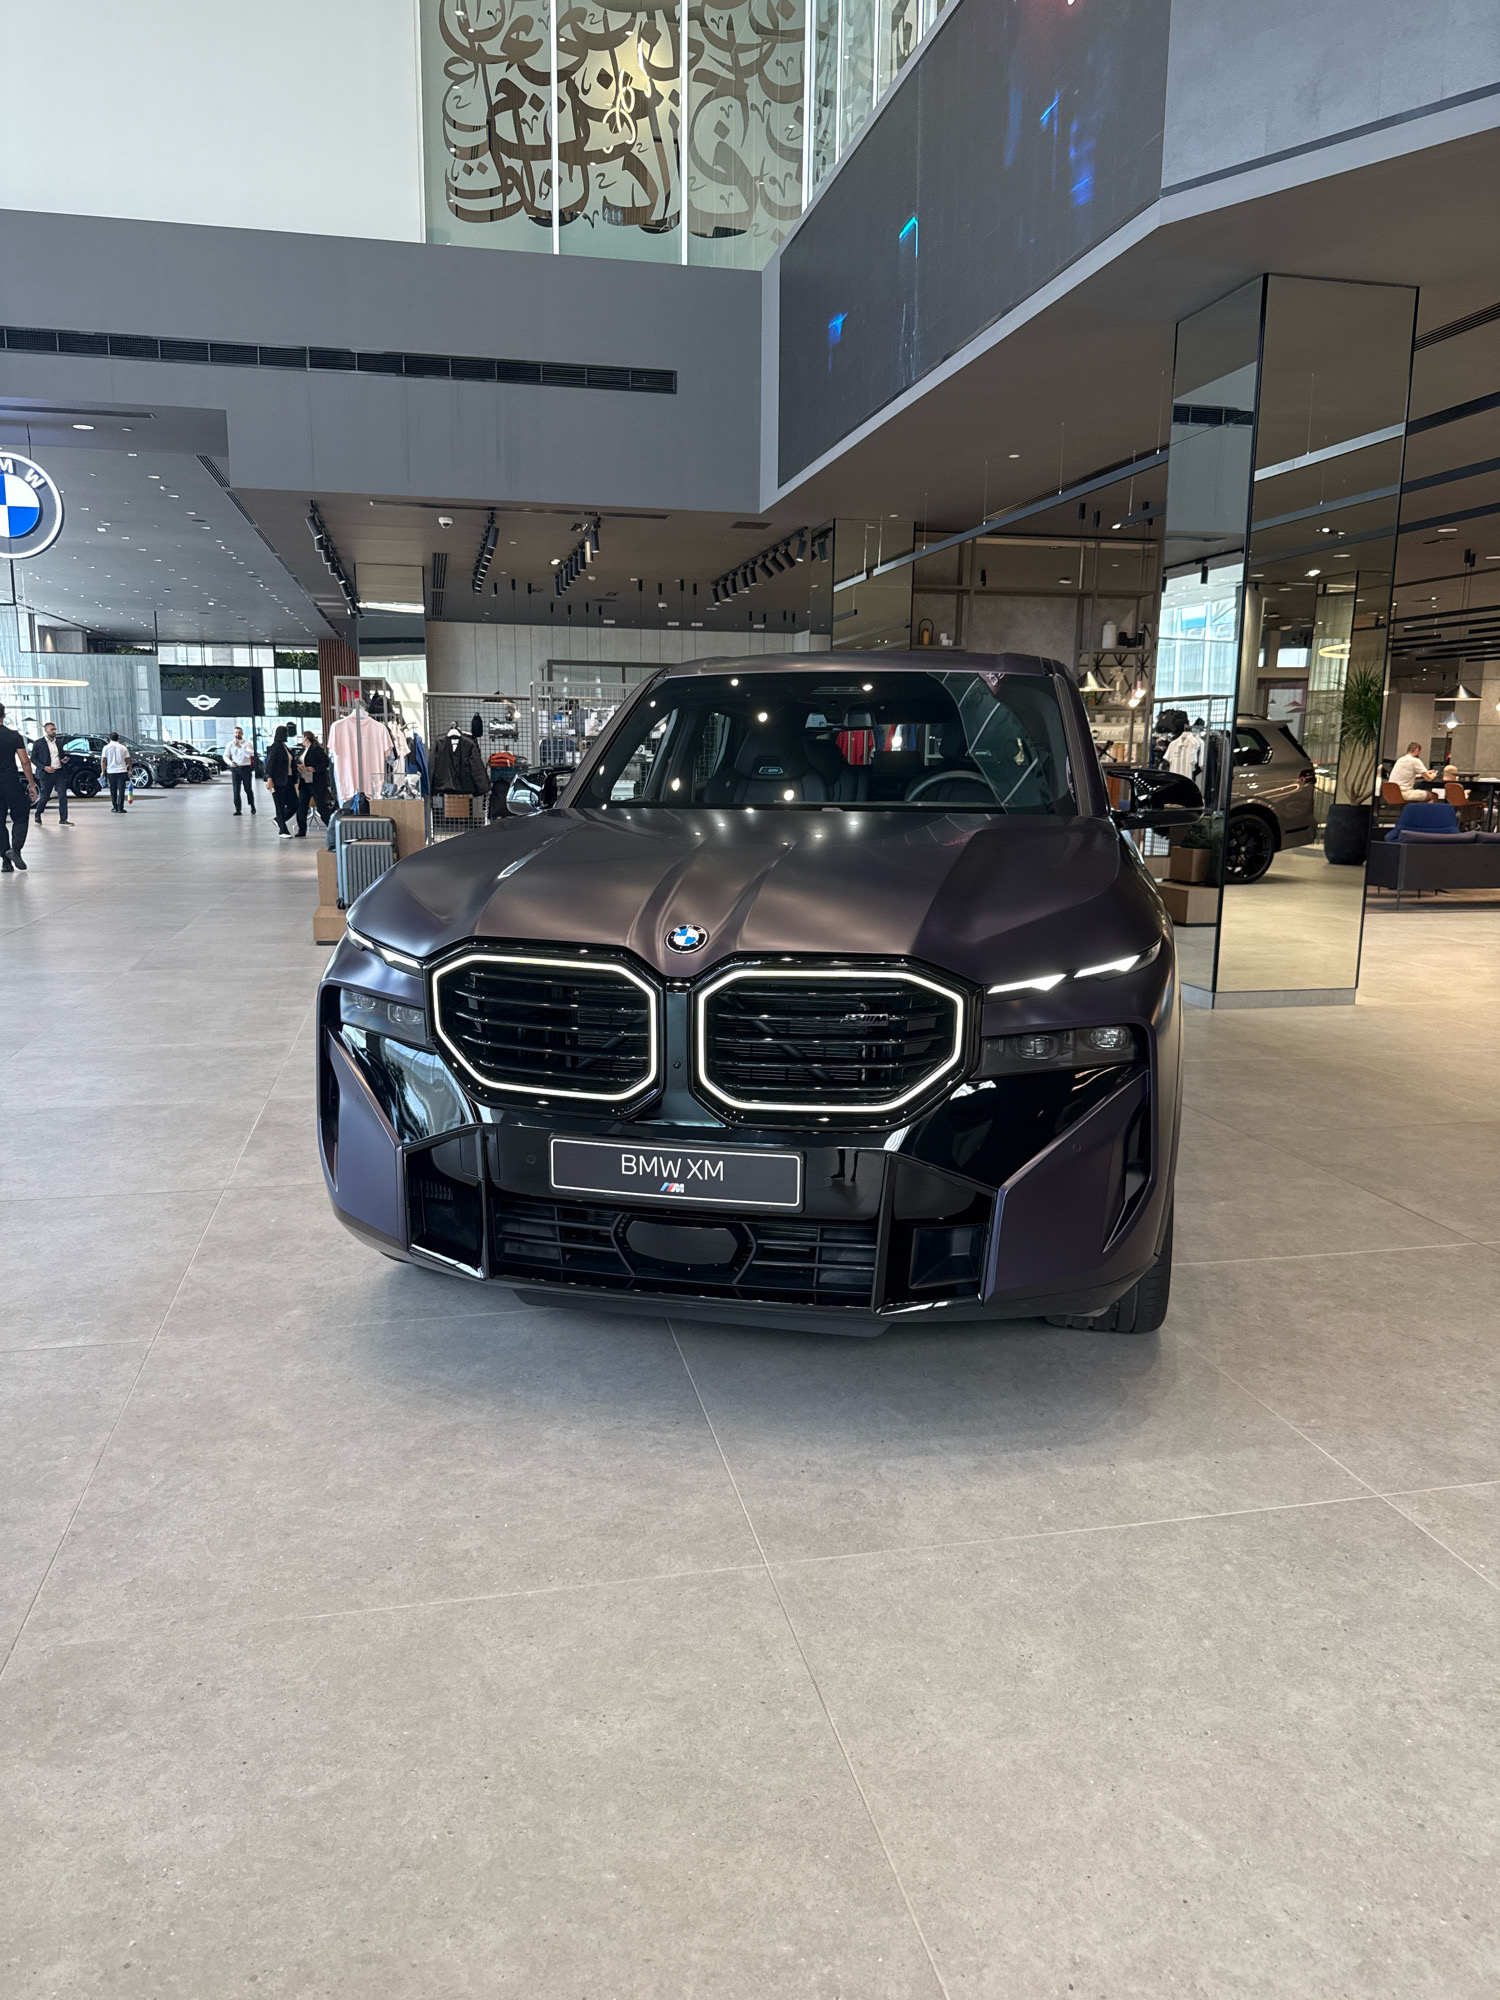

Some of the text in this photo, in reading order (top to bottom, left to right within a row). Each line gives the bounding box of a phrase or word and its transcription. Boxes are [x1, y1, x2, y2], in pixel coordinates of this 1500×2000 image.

[0, 458, 46, 489] MW
[621, 1153, 724, 1182] BMW XM
